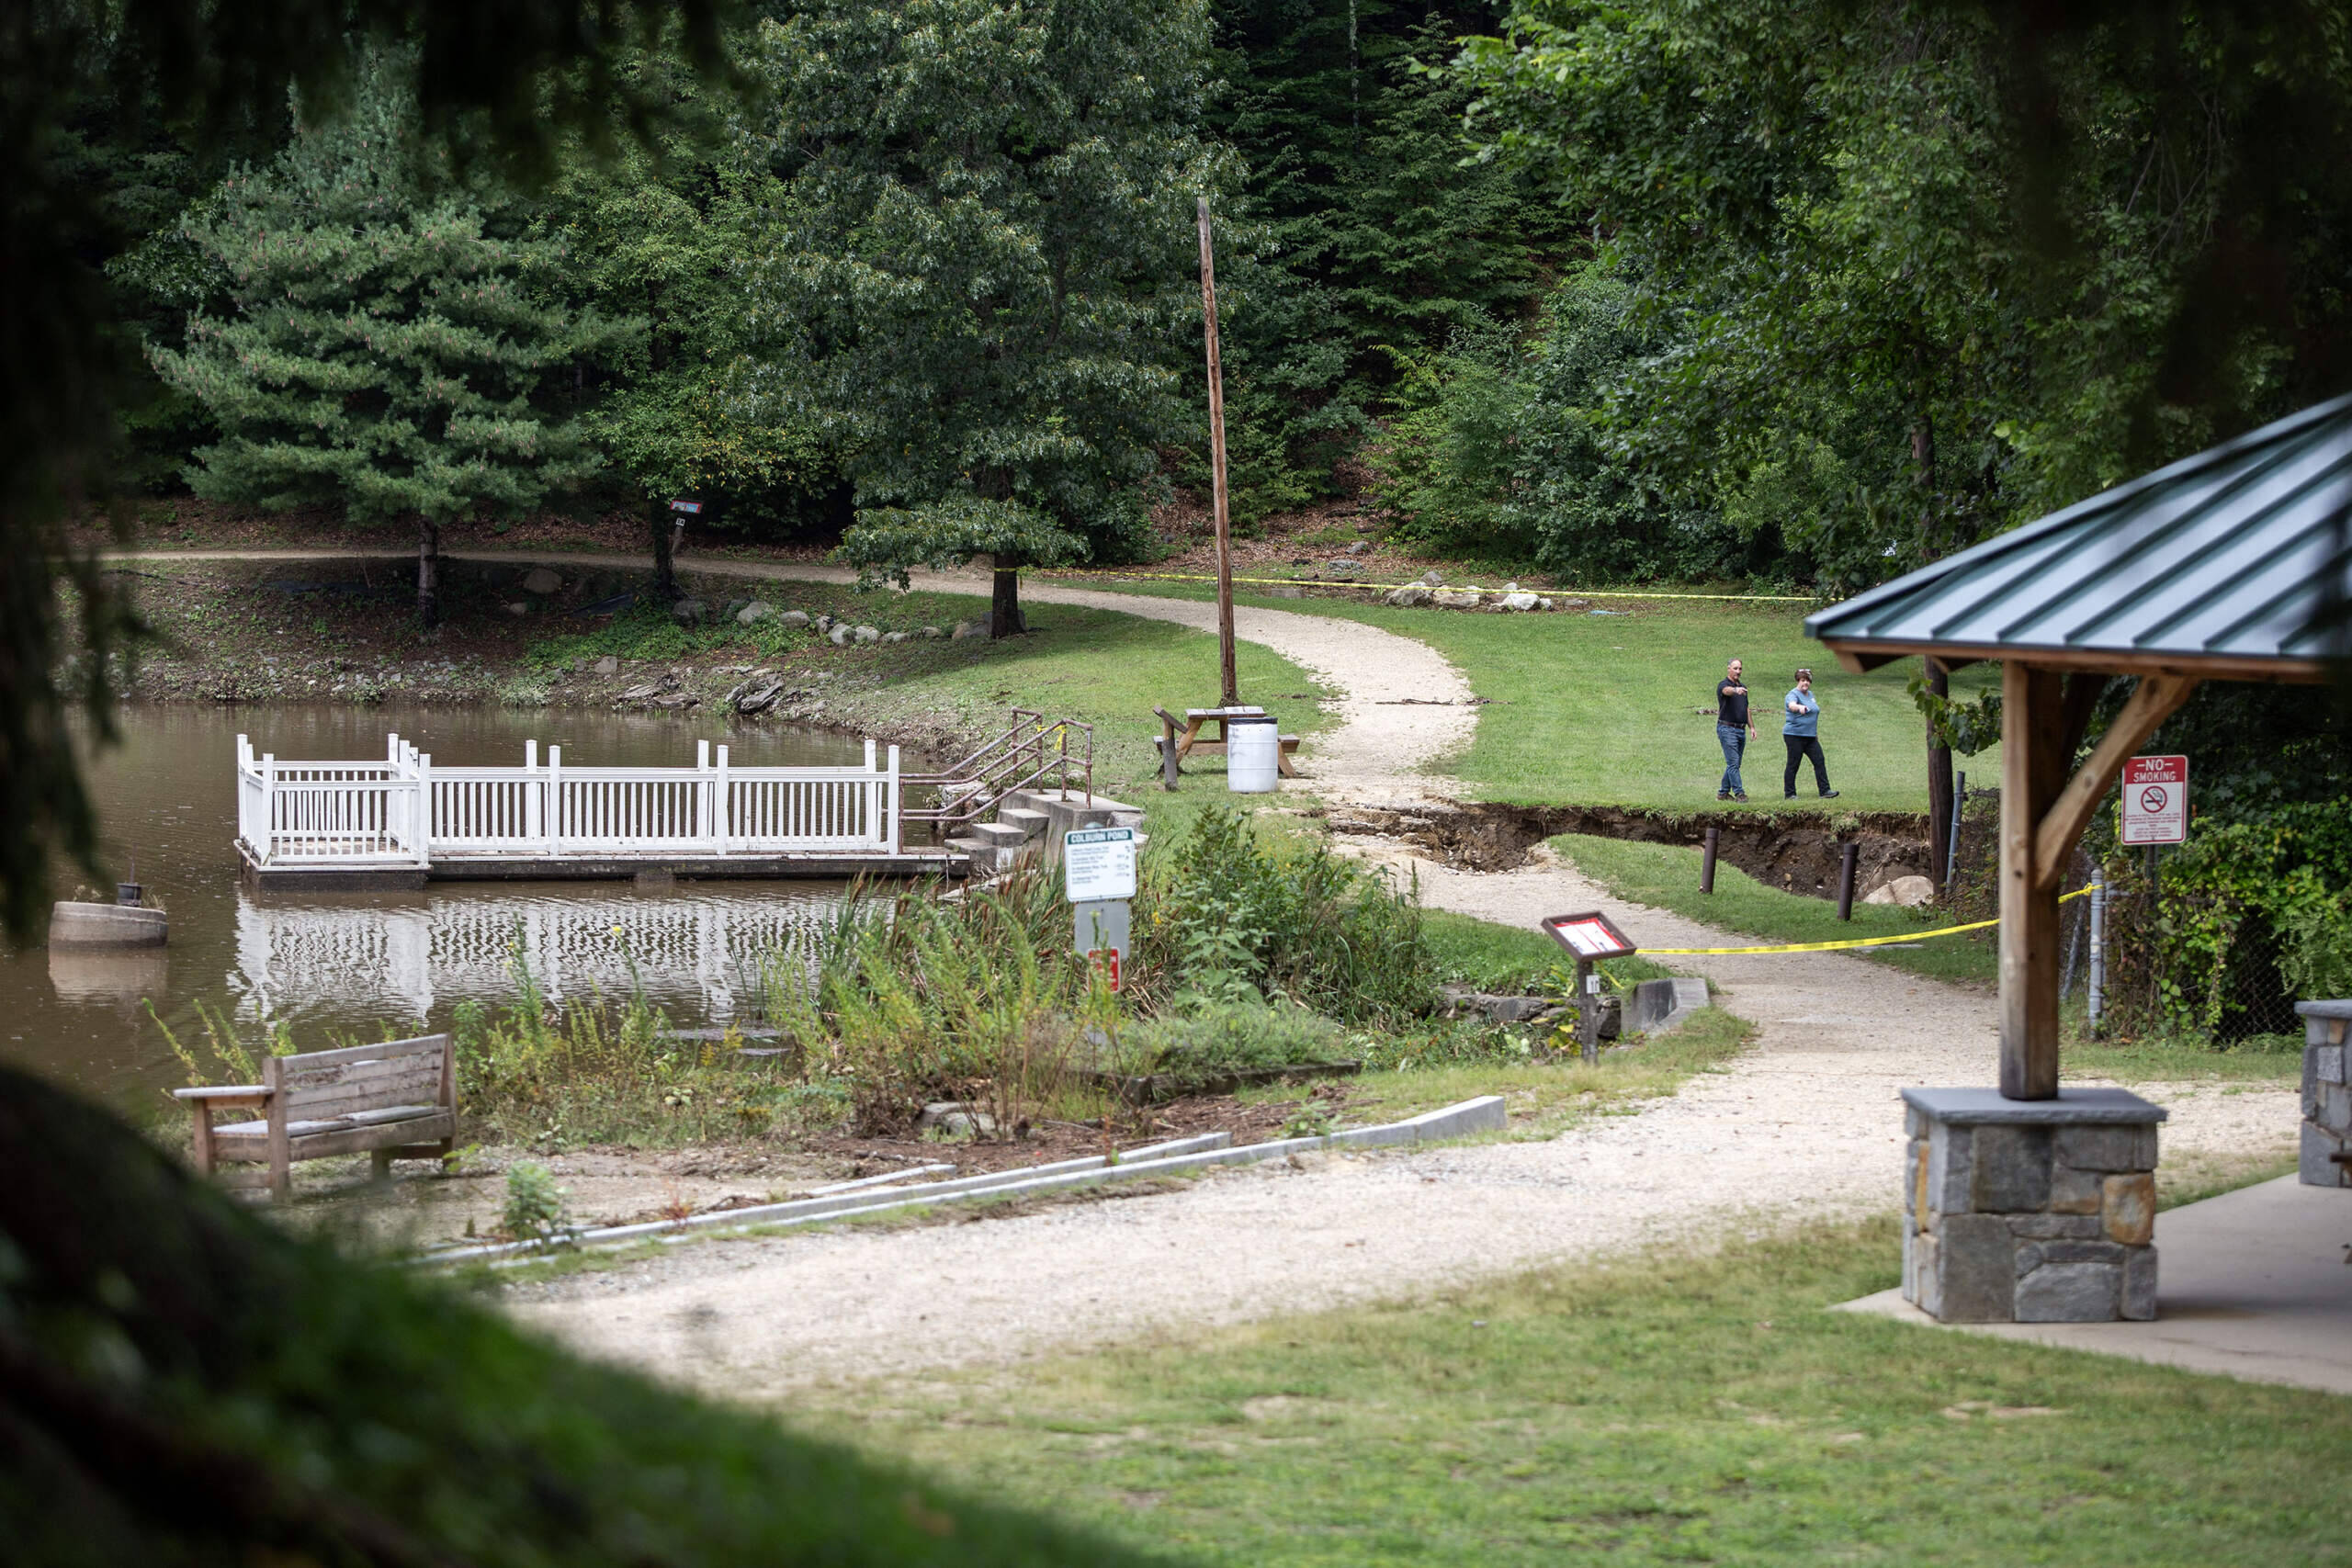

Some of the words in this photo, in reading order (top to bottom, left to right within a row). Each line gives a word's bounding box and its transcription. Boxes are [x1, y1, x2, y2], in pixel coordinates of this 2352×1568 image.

[2145, 759, 2164, 771] NO
[2133, 772, 2177, 782] SMOKING
[1070, 831, 1106, 842] COLBURN
[1107, 830, 1128, 840] POND
